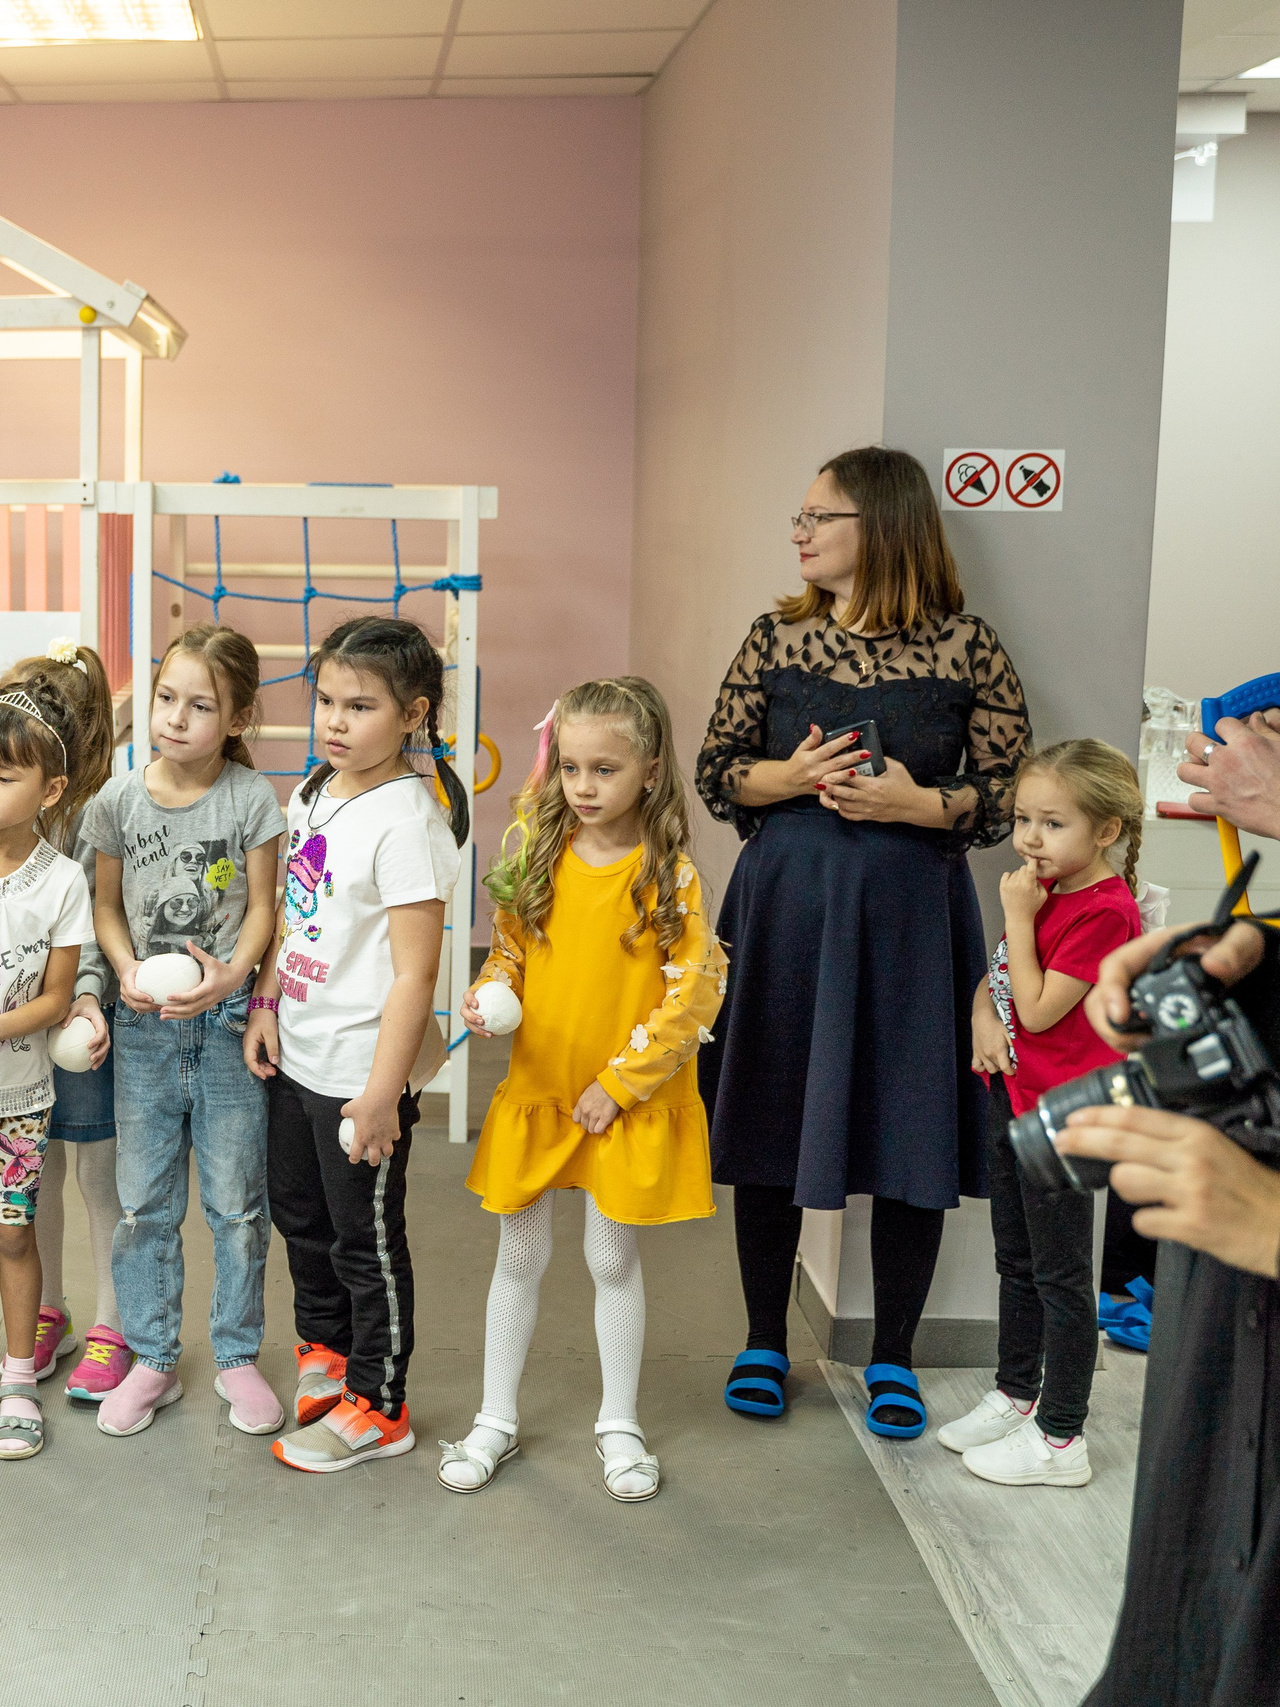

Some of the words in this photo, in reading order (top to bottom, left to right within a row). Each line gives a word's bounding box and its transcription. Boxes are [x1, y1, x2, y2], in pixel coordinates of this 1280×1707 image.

[136, 824, 171, 850] best
[132, 841, 171, 873] iend
[216, 864, 230, 874] SAY
[285, 950, 330, 984] SPACE
